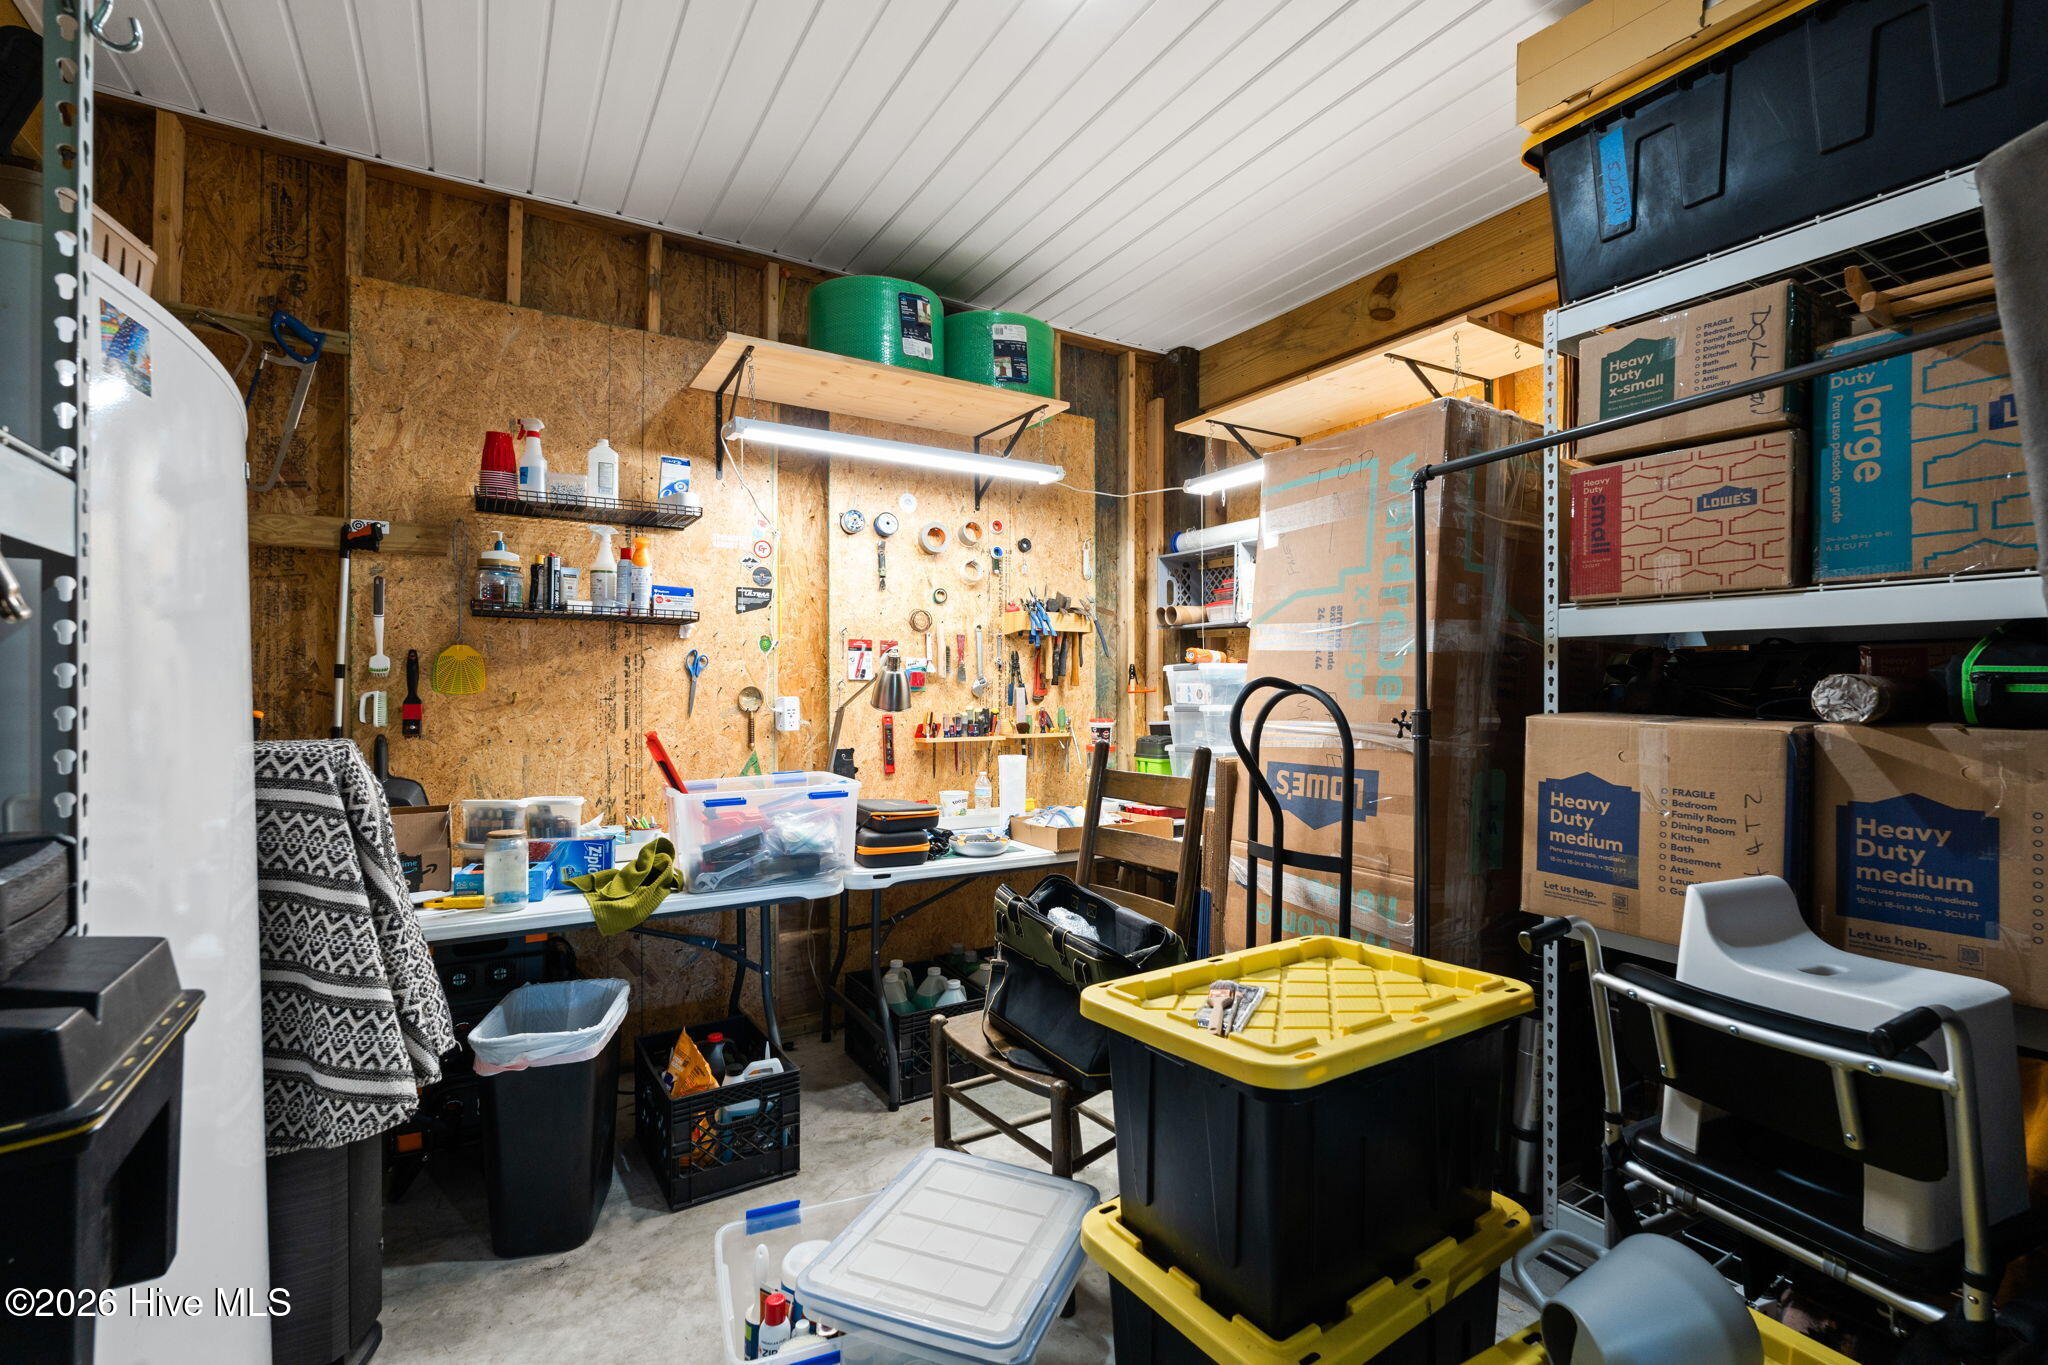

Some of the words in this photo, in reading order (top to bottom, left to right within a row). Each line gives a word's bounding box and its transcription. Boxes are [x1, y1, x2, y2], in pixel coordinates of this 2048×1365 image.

[1704, 316, 1734, 330] FRAGILE
[1703, 325, 1735, 338] Bedroom
[1703, 333, 1726, 345] Family
[1727, 329, 1748, 341] Room
[1703, 342, 1725, 354] Dining
[1726, 337, 1748, 349] Room
[1703, 349, 1730, 360] Kitchen
[1609, 353, 1654, 373] Heavy
[1702, 362, 1738, 376] Basement
[1703, 358, 1719, 368] Bath
[1609, 369, 1642, 385] Duty
[1701, 379, 1731, 391] Laundry
[1702, 374, 1719, 384] Attic
[1830, 371, 1876, 390] Duty
[1609, 373, 1664, 398] x-small
[1831, 395, 1844, 420] Para
[1831, 421, 1841, 440] uso
[1844, 384, 1893, 483] large
[1829, 442, 1844, 484] pesado,
[1309, 450, 1374, 494] TOP
[1583, 478, 1610, 488] Heavy
[1583, 486, 1603, 495] Duty
[1703, 493, 1751, 509] LOWE'S
[1829, 485, 1844, 524] grande
[1591, 494, 1611, 555] small
[1375, 452, 1417, 703] wardrobe
[1275, 769, 1365, 811] LOWE'S
[1672, 788, 1716, 800] FRAGILE
[1550, 791, 1611, 816] Heavy
[1671, 799, 1717, 811] Bedroom
[1550, 808, 1594, 831] Duty
[1671, 810, 1704, 822] Family
[1706, 814, 1737, 825] Room
[1671, 821, 1703, 834] Dining
[1705, 825, 1736, 836] Room
[1856, 817, 1952, 847] Heavy
[1550, 831, 1623, 852] medium
[1670, 832, 1710, 844] Kitchen
[1670, 843, 1694, 853] Bath
[1856, 839, 1926, 866] Duty
[584, 846, 602, 874] Ziplo
[1670, 854, 1722, 869] Basement
[1670, 865, 1694, 875] Attic
[1670, 876, 1701, 886] Laun
[1856, 866, 1974, 894] medium
[1544, 880, 1558, 891] Let
[1560, 885, 1571, 893] us
[1573, 886, 1597, 899] help.
[1856, 884, 1877, 894] Para
[1878, 888, 1894, 896] uso
[1968, 913, 1981, 921] FT
[1848, 928, 1871, 940] Let
[1874, 934, 1890, 944] us
[1894, 935, 1932, 951] help.
